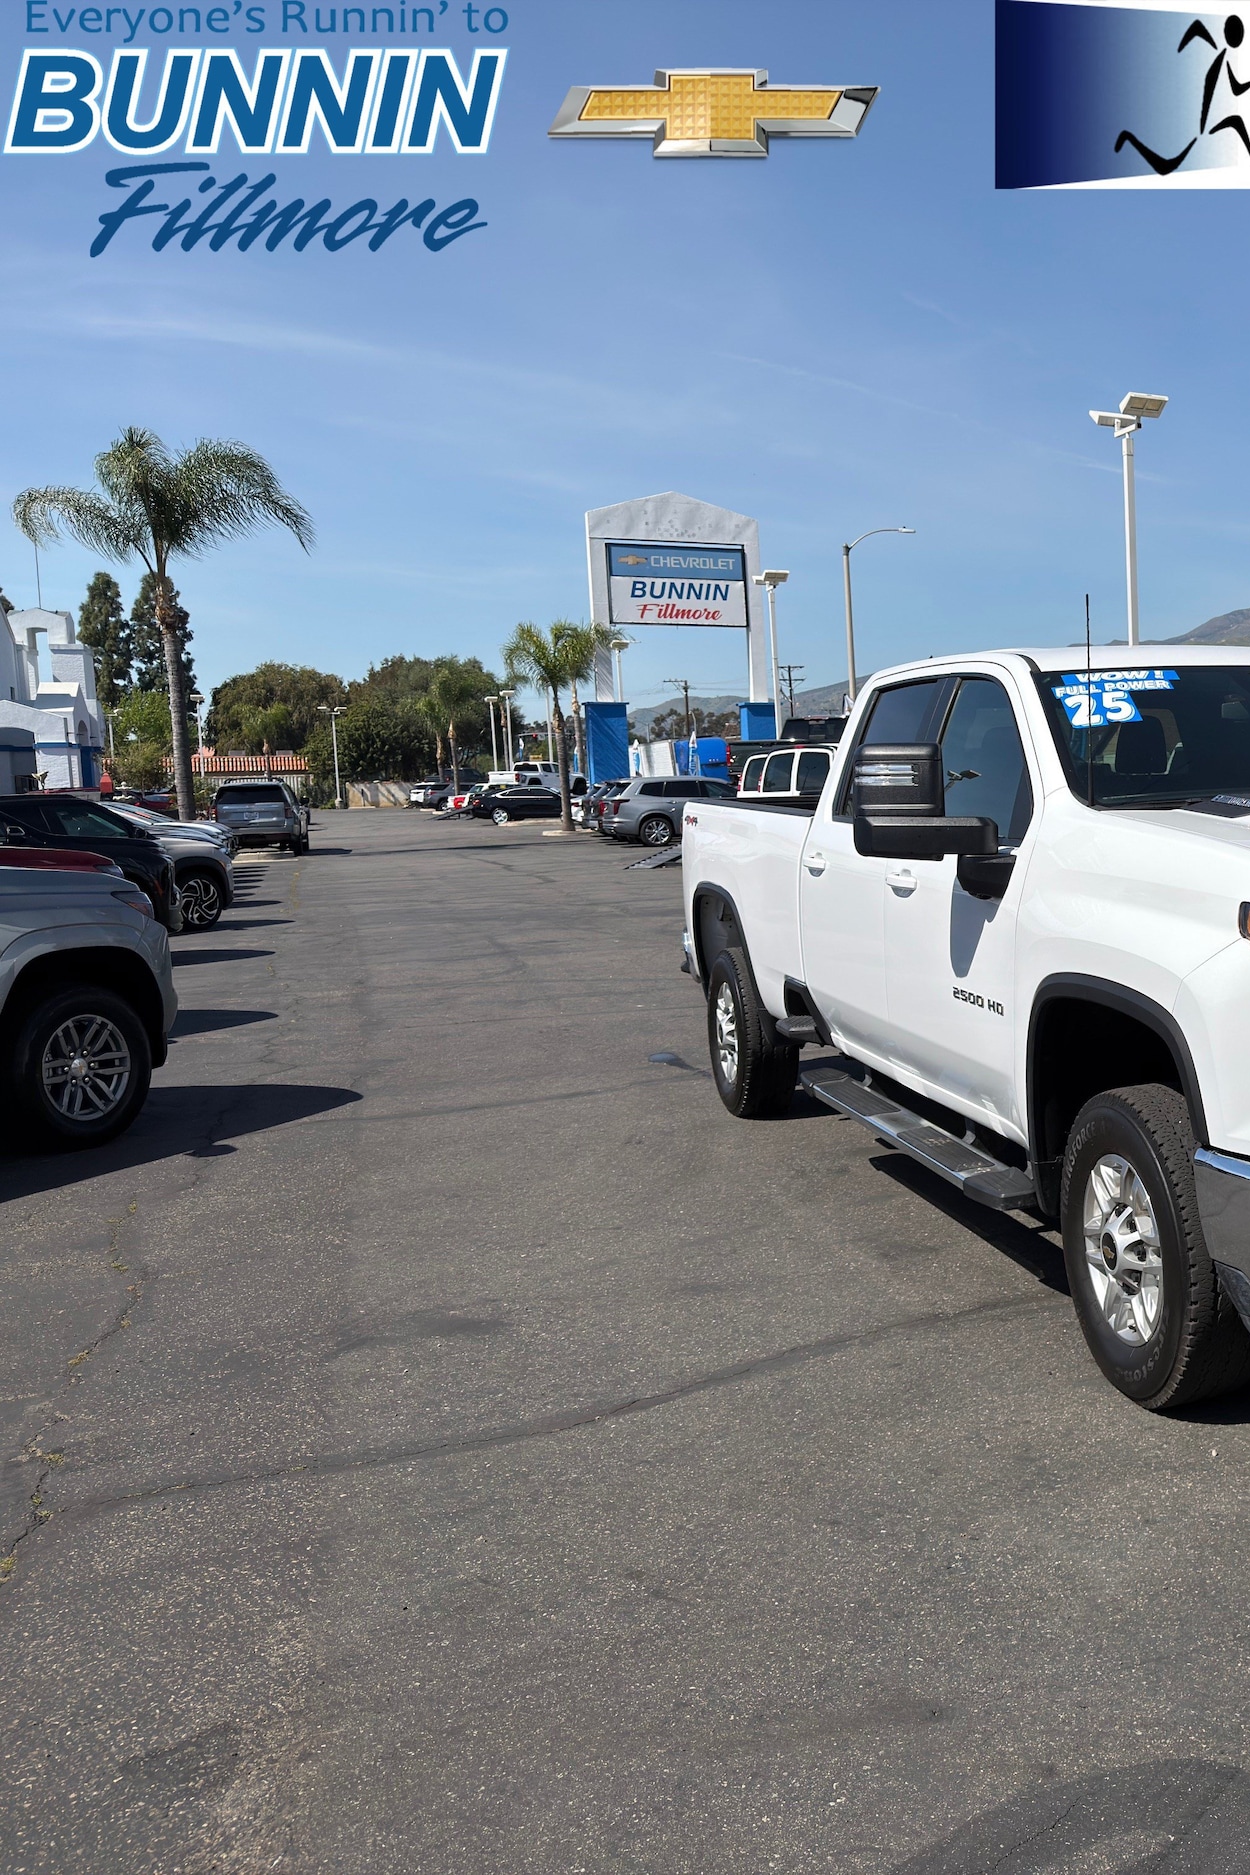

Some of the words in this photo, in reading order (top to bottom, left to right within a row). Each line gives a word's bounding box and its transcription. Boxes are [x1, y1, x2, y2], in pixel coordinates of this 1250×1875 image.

[650, 555, 736, 571] CHEVROLET
[630, 580, 730, 601] BUNNIN
[636, 602, 723, 621] Fillmore
[1054, 684, 1103, 699] FULL
[1103, 679, 1171, 692] POWER
[1063, 690, 1136, 728] 25
[952, 986, 985, 1009] 2500
[987, 998, 1005, 1017] HD
